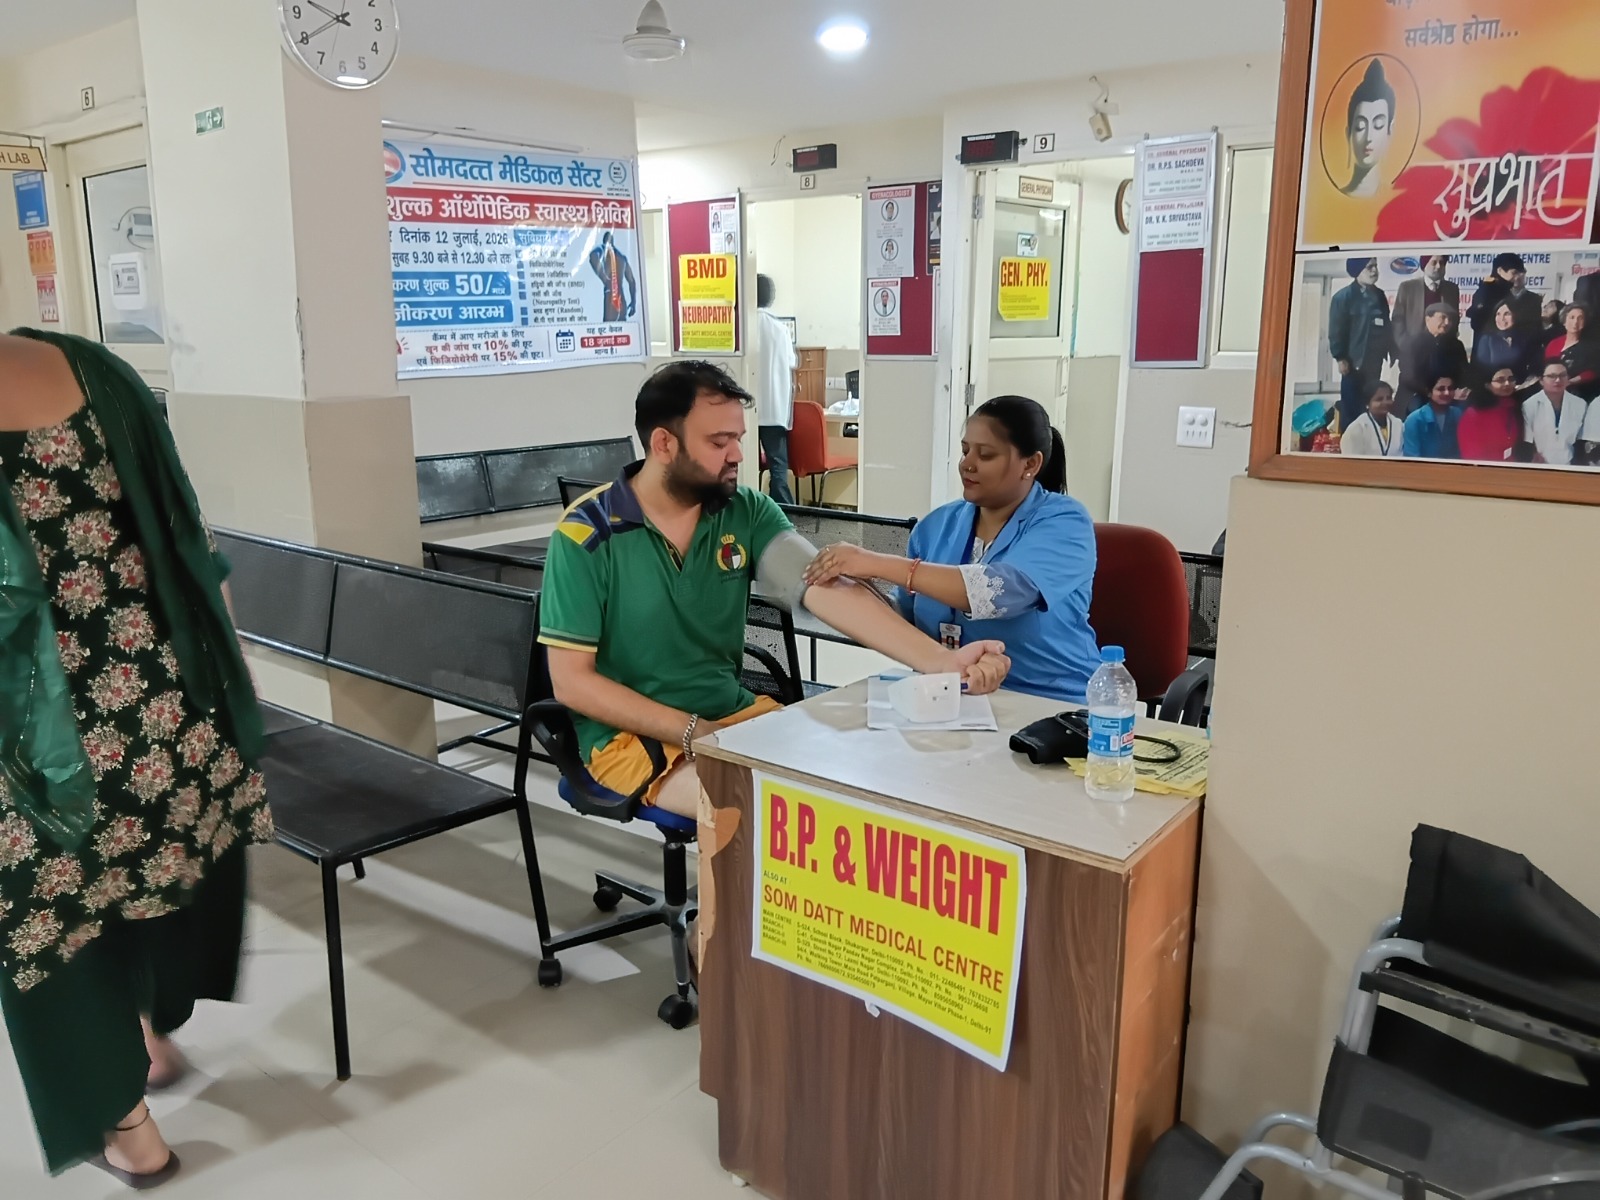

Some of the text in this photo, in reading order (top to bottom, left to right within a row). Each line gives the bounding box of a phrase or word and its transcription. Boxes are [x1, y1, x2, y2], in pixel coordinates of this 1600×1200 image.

[292, 5, 301, 19] 9
[374, 18, 382, 31] 3
[300, 31, 309, 45] 8
[371, 41, 378, 55] 4
[317, 51, 325, 65] 7
[358, 56, 366, 70] 5
[339, 60, 347, 74] 6
[85, 92, 90, 106] 6
[1040, 137, 1047, 149] 9
[7, 152, 31, 164] LAB
[1175, 158, 1204, 168] SACHDEVA
[410, 148, 602, 188] सोमदत्त मेडिकल सेंटर
[804, 177, 810, 187] 8
[1418, 151, 1592, 241] सुप्रभात
[439, 191, 530, 221] ऑर्थोपेडिक
[534, 203, 588, 223] स्वास्थ्य
[591, 201, 630, 224] शिविर
[1145, 216, 1154, 224] DR.
[1169, 212, 1202, 222] SRIVASTAVA
[400, 227, 430, 244] दिनांक
[436, 231, 448, 244] 12
[392, 252, 409, 268] सुबह
[412, 251, 434, 264] 9.30
[437, 249, 449, 264] बजे
[451, 249, 458, 264] से
[461, 251, 485, 264] 12.30
[687, 259, 727, 279] BMD
[1001, 261, 1048, 287] GEN. PHY.
[423, 279, 449, 295] शुल्क
[459, 305, 505, 320] आरम्भ
[682, 306, 732, 324] NEUROPATHY
[472, 343, 481, 351] पर
[484, 340, 509, 351] 10%
[583, 338, 594, 347] 18
[481, 354, 490, 362] पर
[493, 351, 517, 362] 15%
[770, 793, 1007, 936] B.P. & WEIGHT
[763, 870, 779, 882] ALSO
[764, 884, 1004, 994] SOM DATT MEDICAL CENTRE
